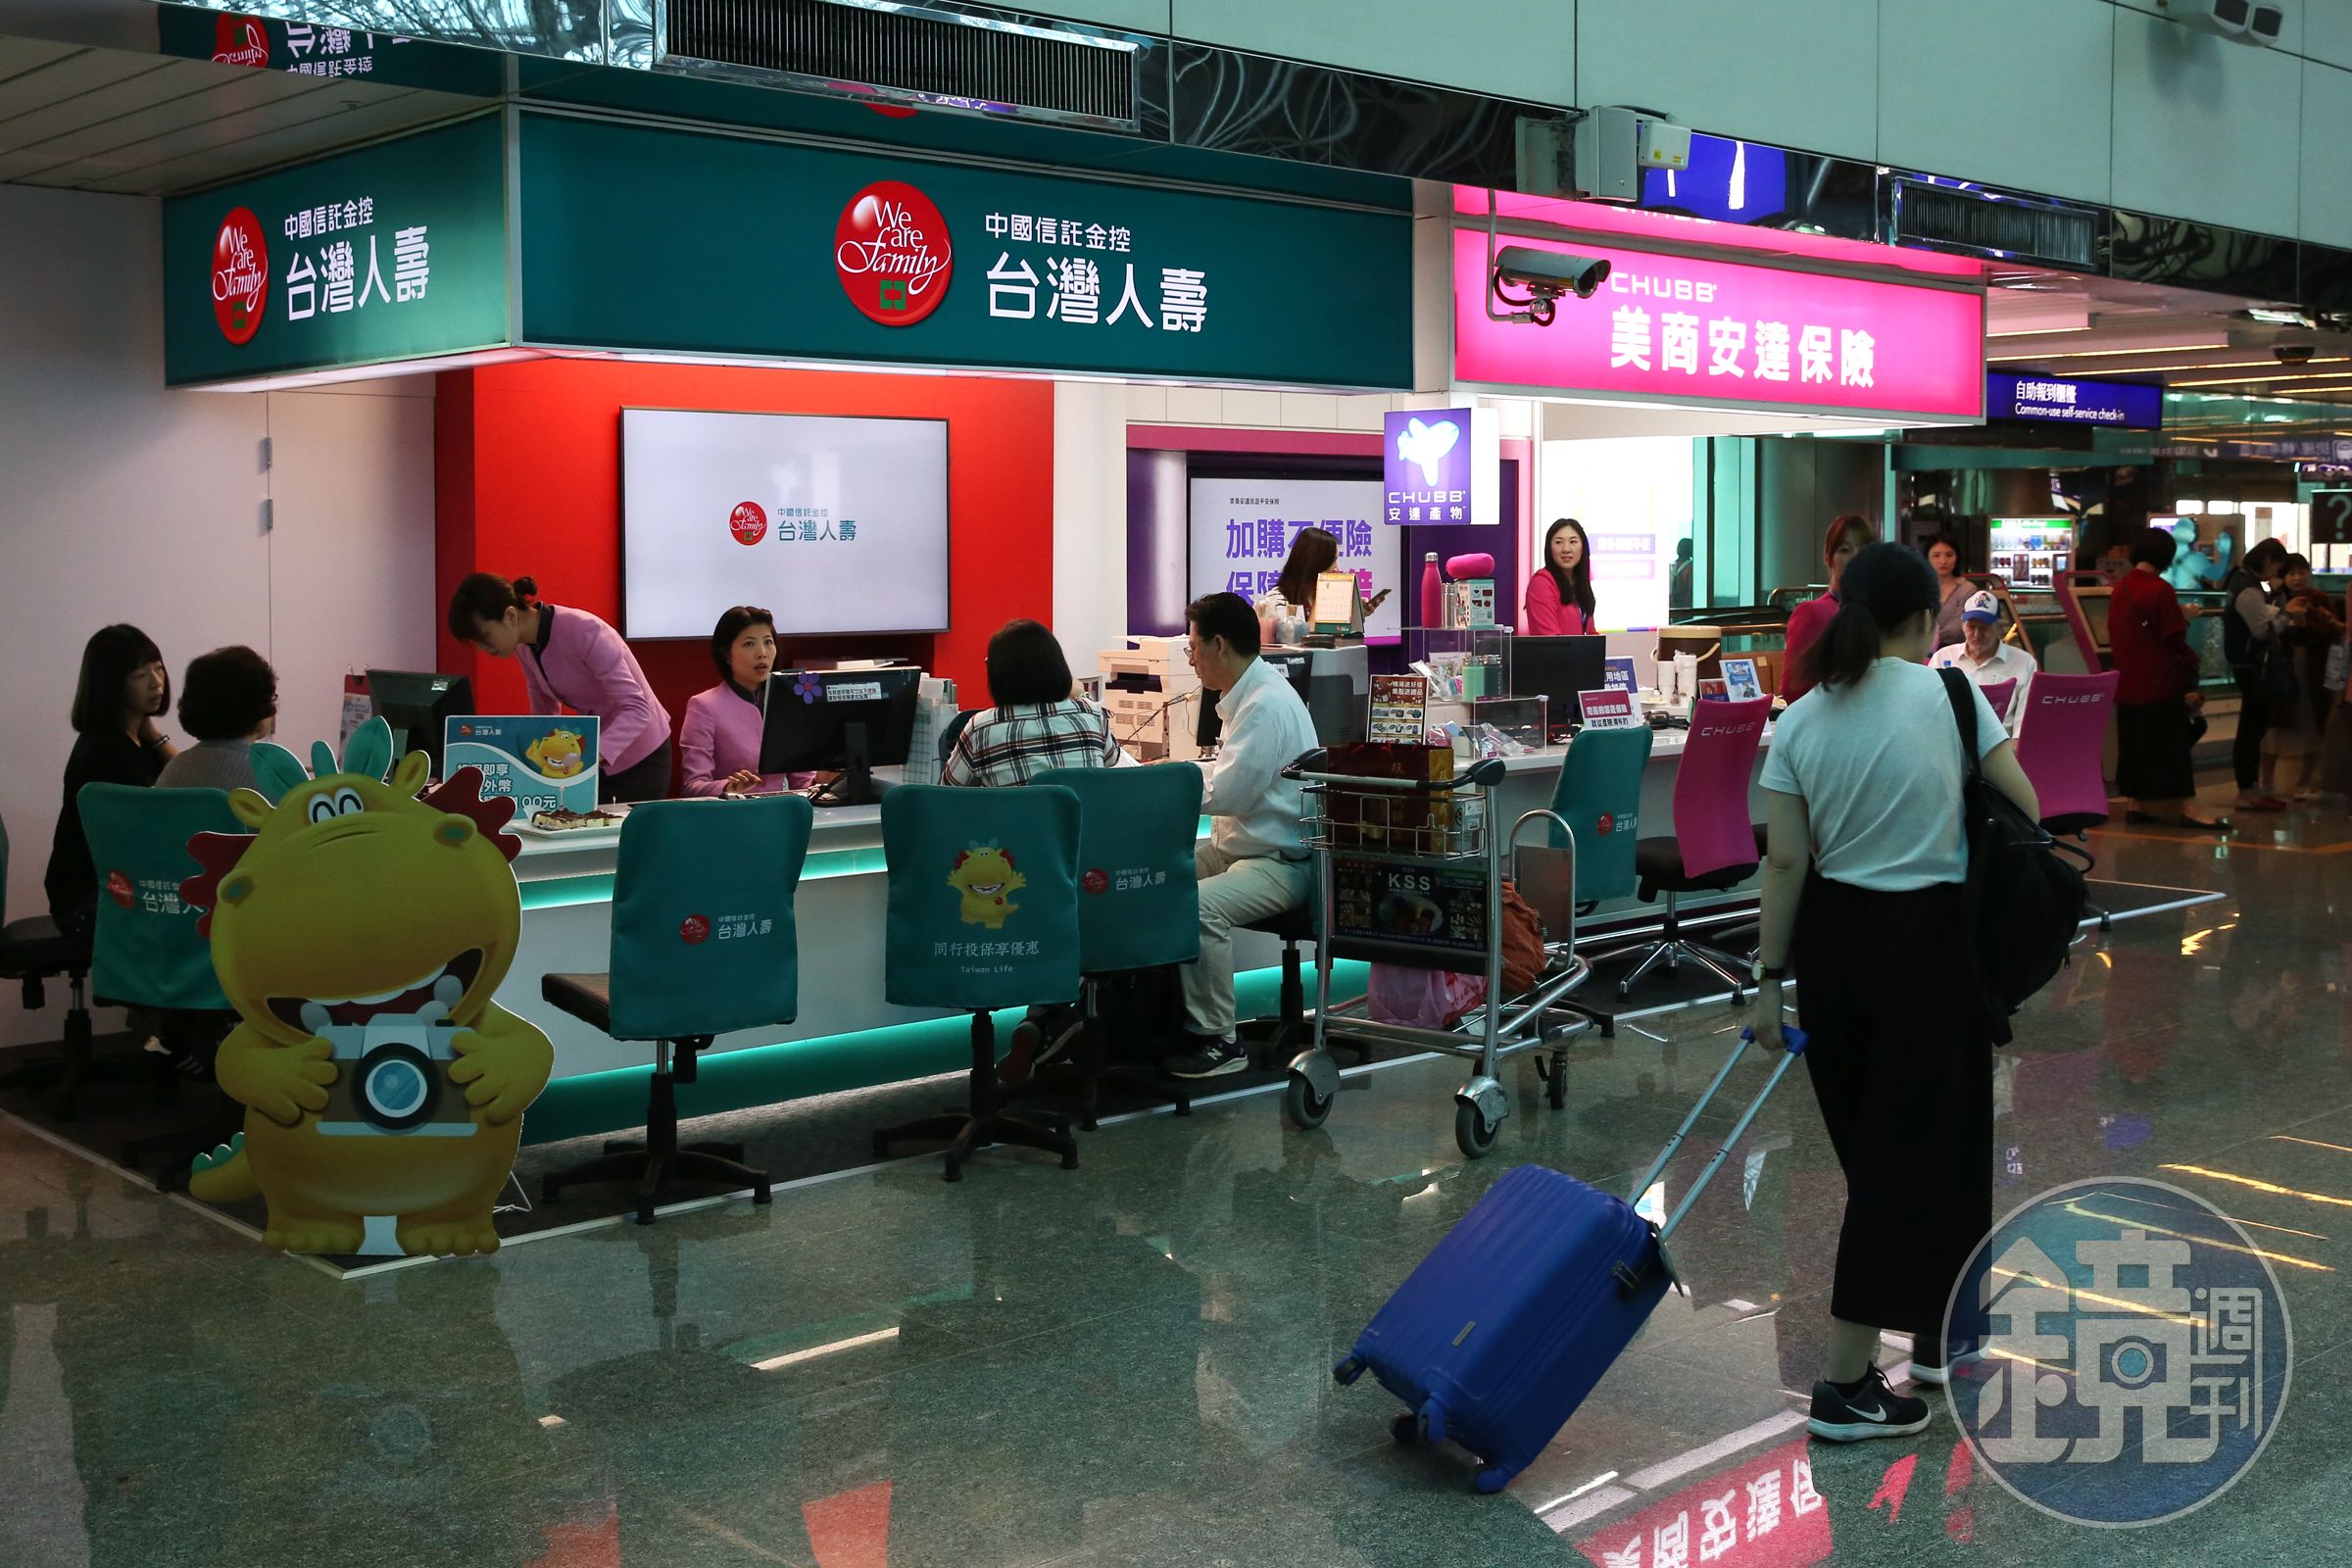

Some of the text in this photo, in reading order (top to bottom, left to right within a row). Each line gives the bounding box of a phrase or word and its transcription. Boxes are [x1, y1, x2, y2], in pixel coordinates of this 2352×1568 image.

[284, 196, 373, 241] 中國信託金控
[874, 201, 912, 229] We
[229, 226, 248, 254] We
[985, 212, 1131, 252] 中國信託金控
[286, 225, 429, 321] 台灣人壽
[837, 226, 952, 295] Family
[213, 253, 268, 313] Family
[986, 251, 1208, 333] 台灣人壽
[1610, 271, 1717, 303] CHUBB
[1610, 304, 1876, 389] 美商安達保險
[1388, 490, 1463, 504] CHUBB
[1389, 506, 1463, 521] 安達產物
[778, 519, 857, 541] 台灣人壽
[2041, 693, 2102, 705] CHUBB
[1115, 870, 1166, 891] 台灣人壽
[1388, 872, 1432, 891] KSS
[717, 918, 772, 940] 台灣人壽
[934, 940, 1040, 956] 同行投保享優惠
[994, 964, 1013, 973] Life
